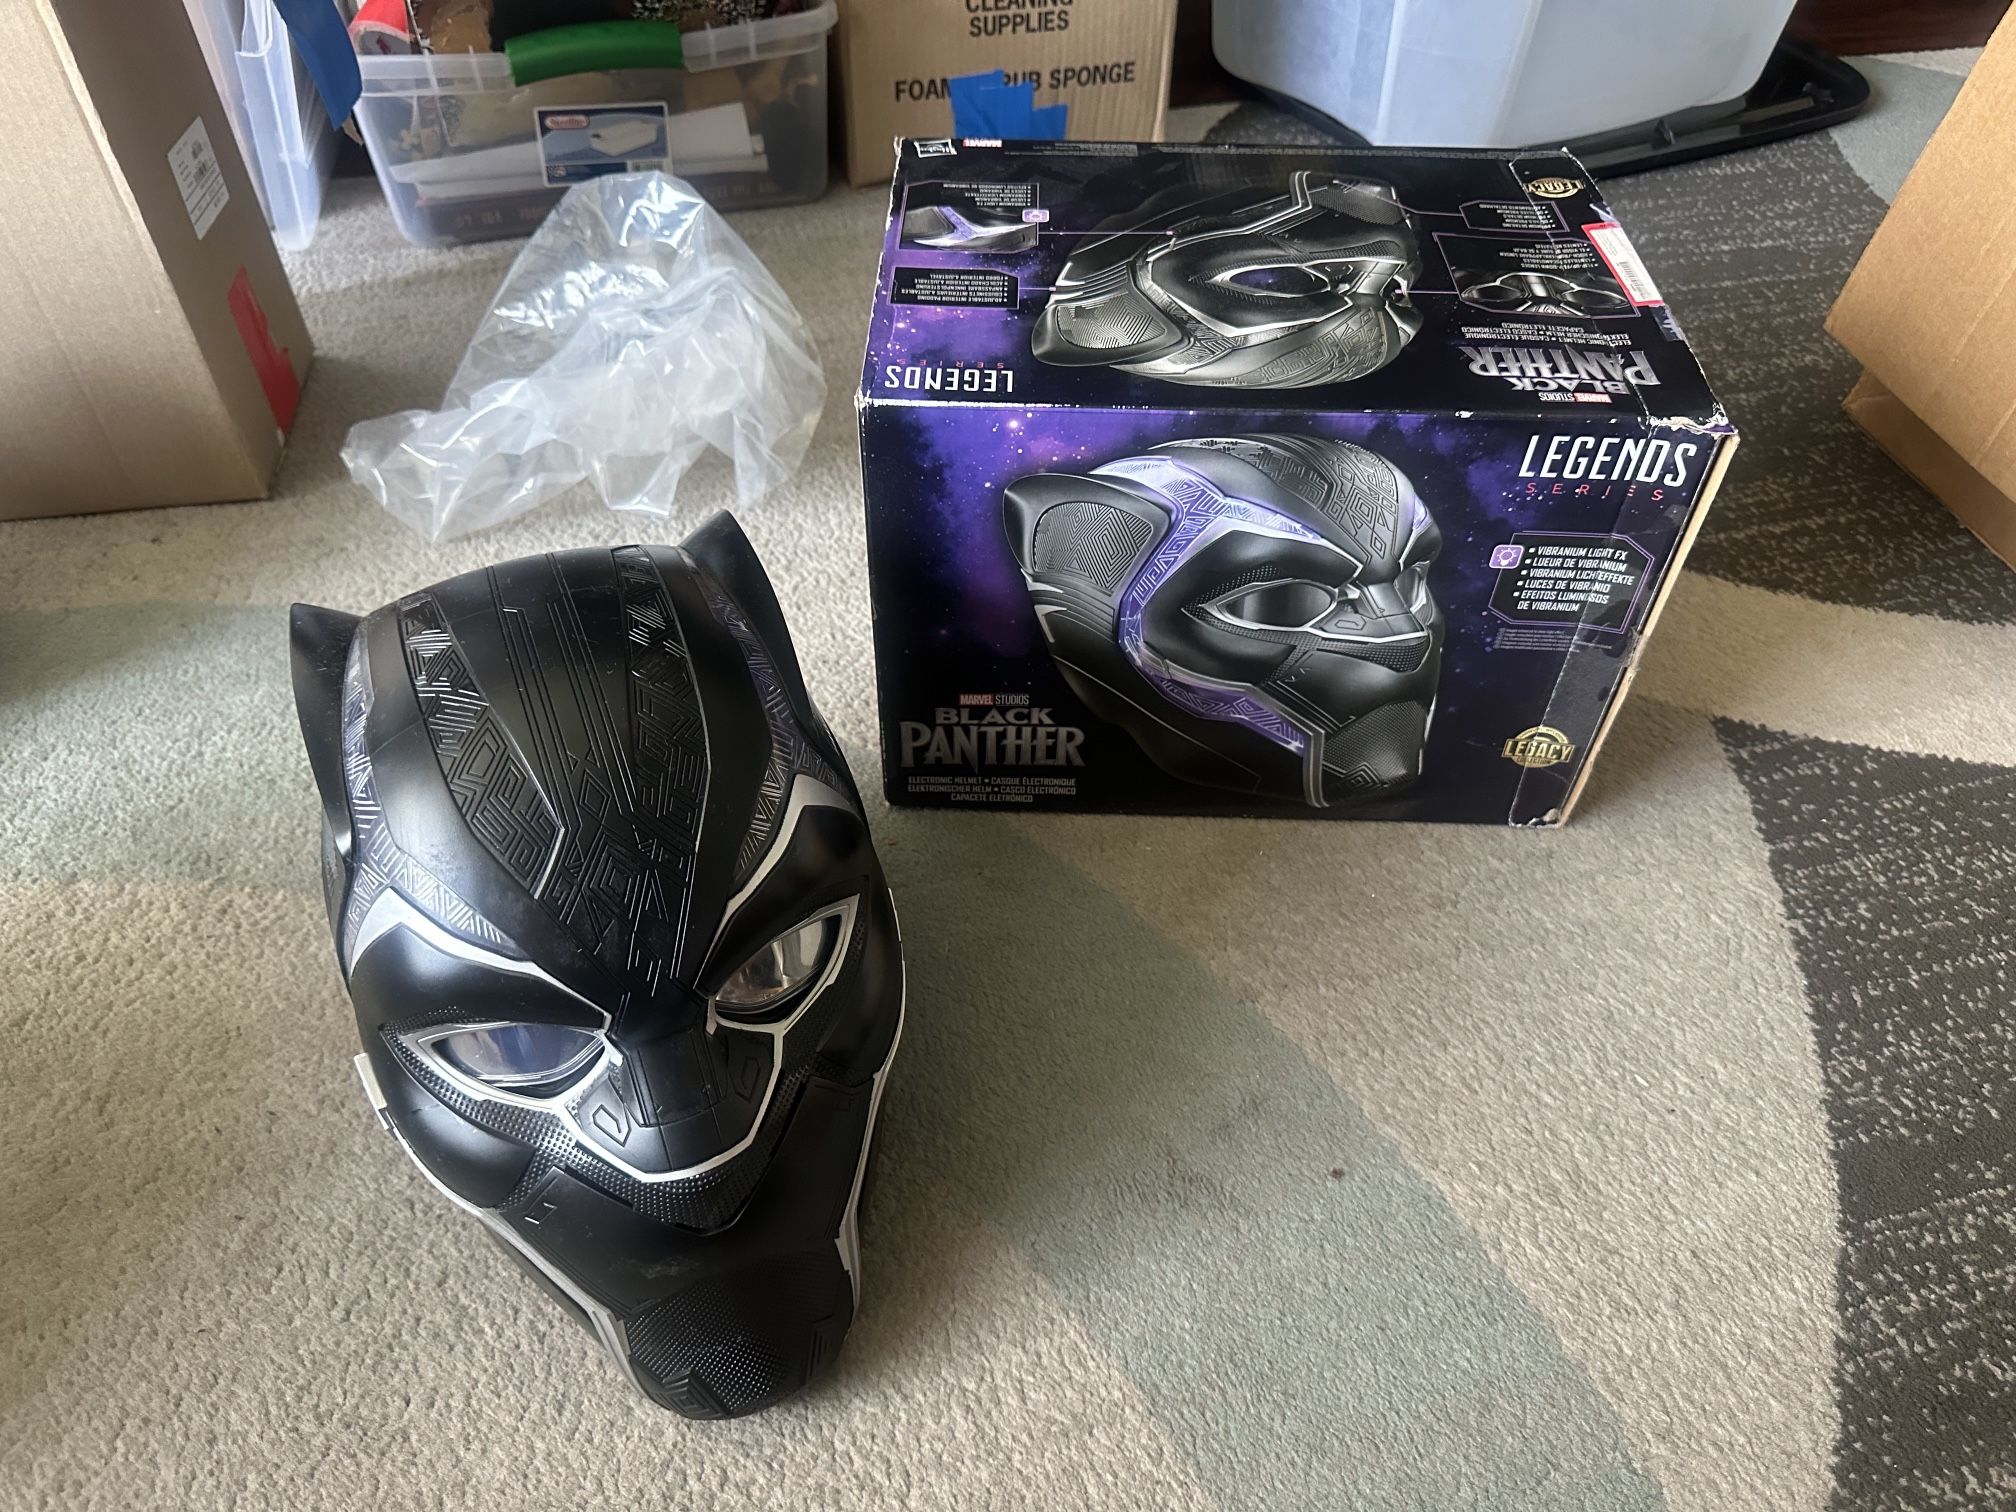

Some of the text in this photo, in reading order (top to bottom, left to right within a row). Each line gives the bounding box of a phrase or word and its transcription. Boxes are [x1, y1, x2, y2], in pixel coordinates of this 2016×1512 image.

[965, 0, 1073, 13] CLEA
[969, 10, 1069, 37] SUPPLIES
[1049, 61, 1136, 90] SPONGE
[1528, 179, 1582, 192] LEGACY
[897, 359, 1005, 369] SERIES
[1458, 344, 1661, 386] PANTHER
[884, 365, 1014, 393] LEGENDS
[1503, 377, 1630, 395] BLACK
[1538, 392, 1612, 403] MARVEL STUDIOS
[1518, 434, 1698, 487] LEGENDS
[1525, 482, 1664, 501] SERIES
[1537, 546, 1628, 561] VIBRANIUM LIGHT FX
[1532, 557, 1628, 573] LUEUR DE VIBRANIUM
[1529, 568, 1576, 579] VIBRANIUM
[1524, 580, 1553, 589] LUCES
[1554, 580, 1568, 589] DE
[1520, 590, 1610, 605] EFEITOS LUMINOSOS
[1517, 601, 1580, 612] DE VIBRANIUM
[959, 693, 1030, 706] MARVEL STUDIOS
[935, 707, 1056, 725] BLACK
[899, 721, 1087, 774] PANTHER
[1504, 741, 1572, 761] LEGACY
[908, 776, 1076, 786] ELECTRONIC HELMET CASQUE ÉLECTRONIQUE
[907, 784, 1076, 795] ELEKTRONISCHER HELM CASCO ELECTRÓNICO
[951, 793, 987, 802] CAPACETE
